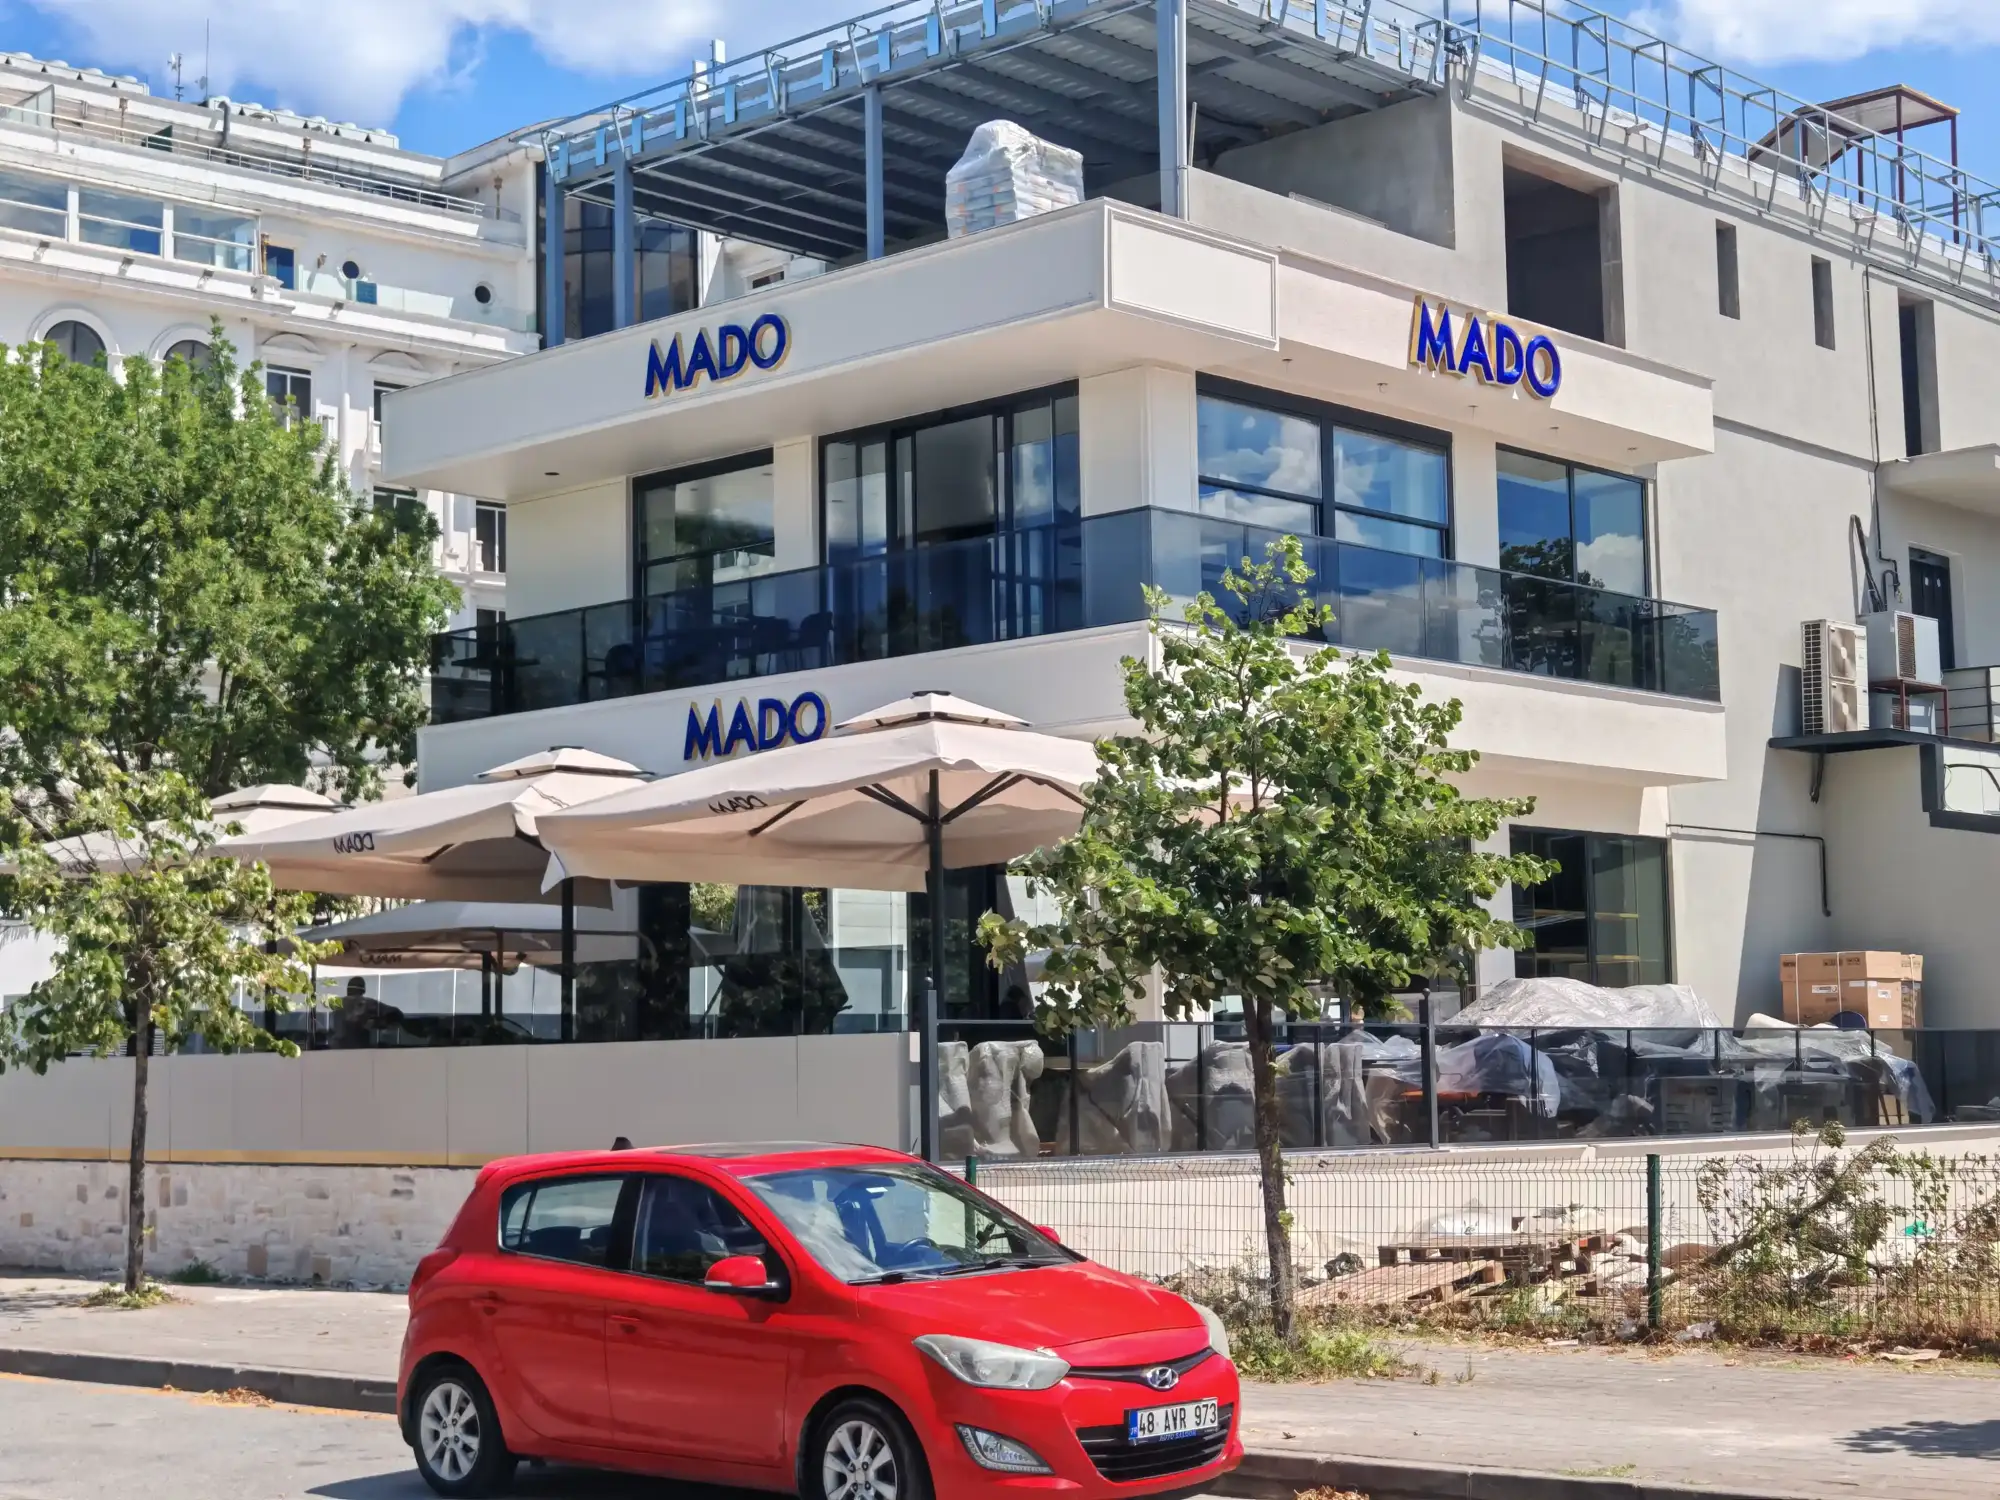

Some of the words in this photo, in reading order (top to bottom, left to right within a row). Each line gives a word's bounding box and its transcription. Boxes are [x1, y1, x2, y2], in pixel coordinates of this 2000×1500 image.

[645, 313, 790, 399] MADO
[1412, 297, 1562, 398] MADO
[684, 691, 829, 761] MADO
[708, 794, 768, 813] MADO
[333, 832, 375, 853] MADO
[1139, 1412, 1155, 1436] 48
[1164, 1408, 1187, 1433] AVR
[1195, 1402, 1217, 1427] 973
